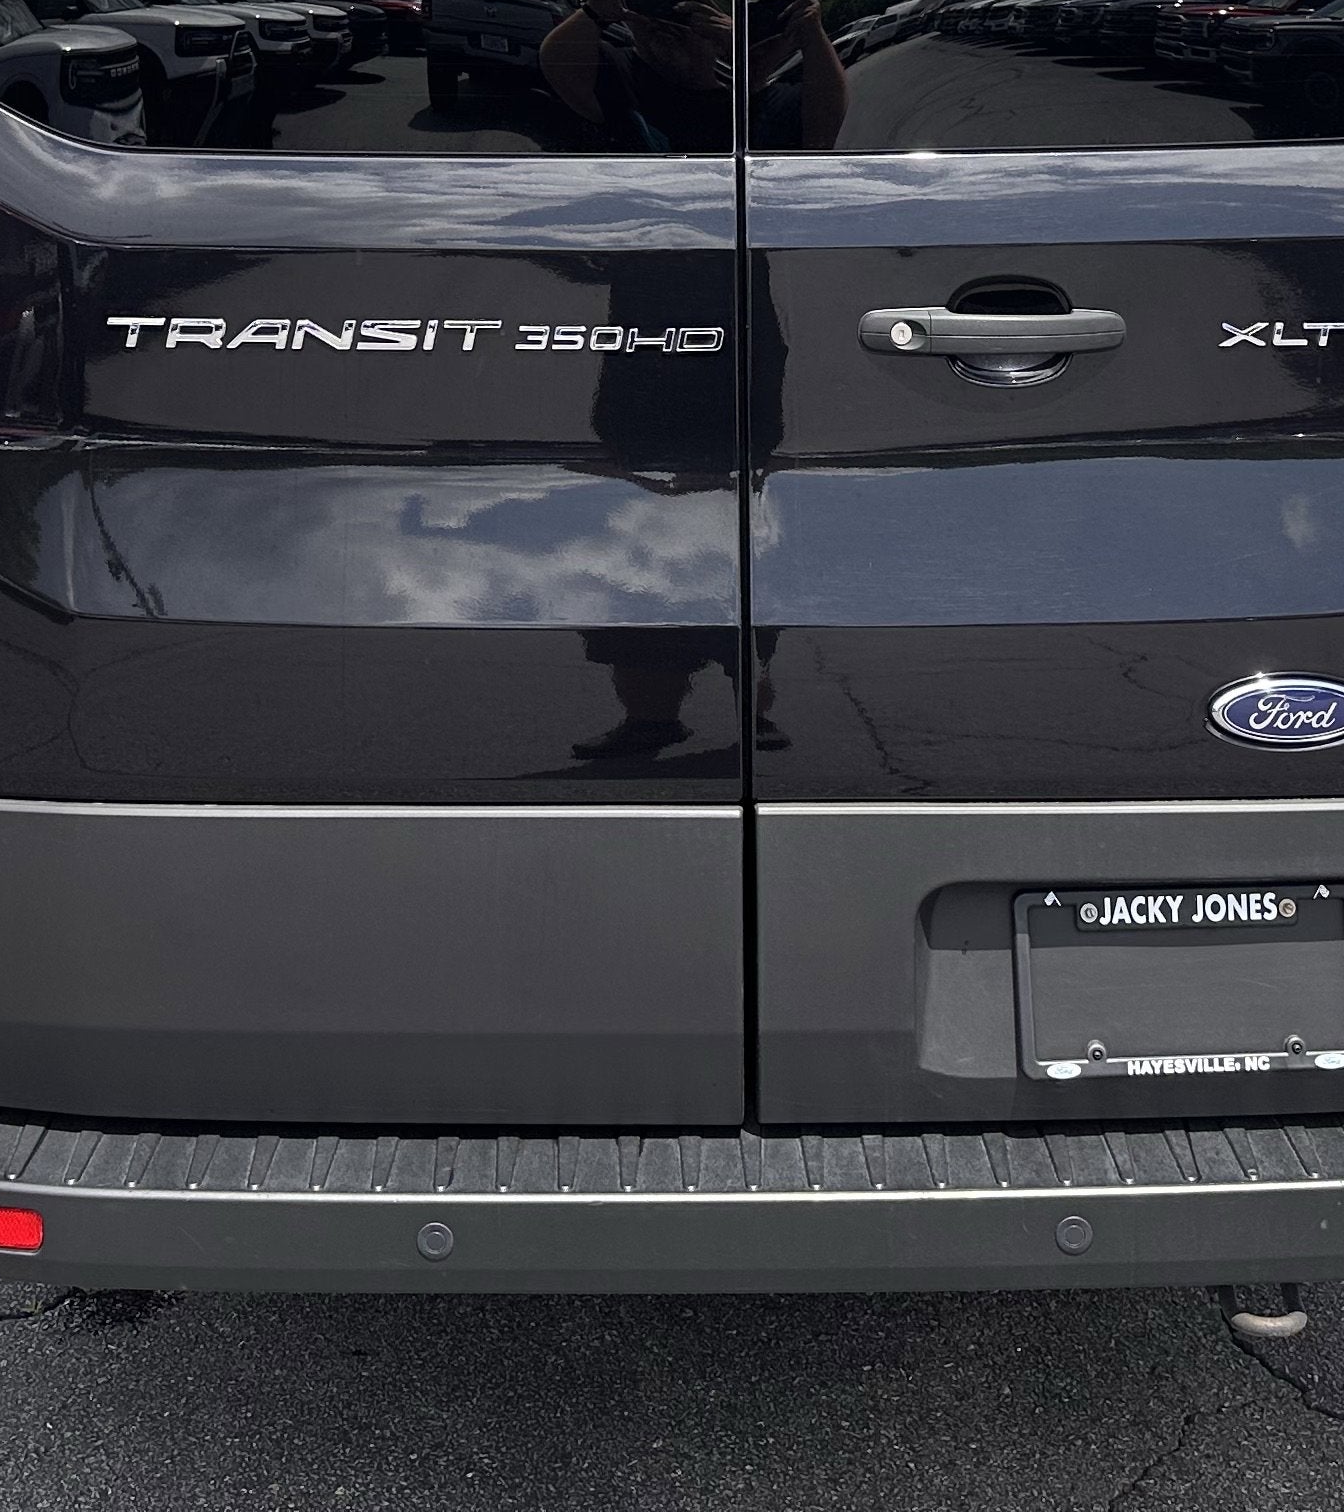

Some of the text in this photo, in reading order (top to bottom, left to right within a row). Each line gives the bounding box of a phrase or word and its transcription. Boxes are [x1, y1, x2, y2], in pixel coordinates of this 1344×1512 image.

[106, 316, 726, 353] TRANSIT 350HD
[1248, 693, 1338, 730] Ford
[1098, 891, 1278, 926] JACKY JONES
[1244, 1055, 1271, 1072] NC
